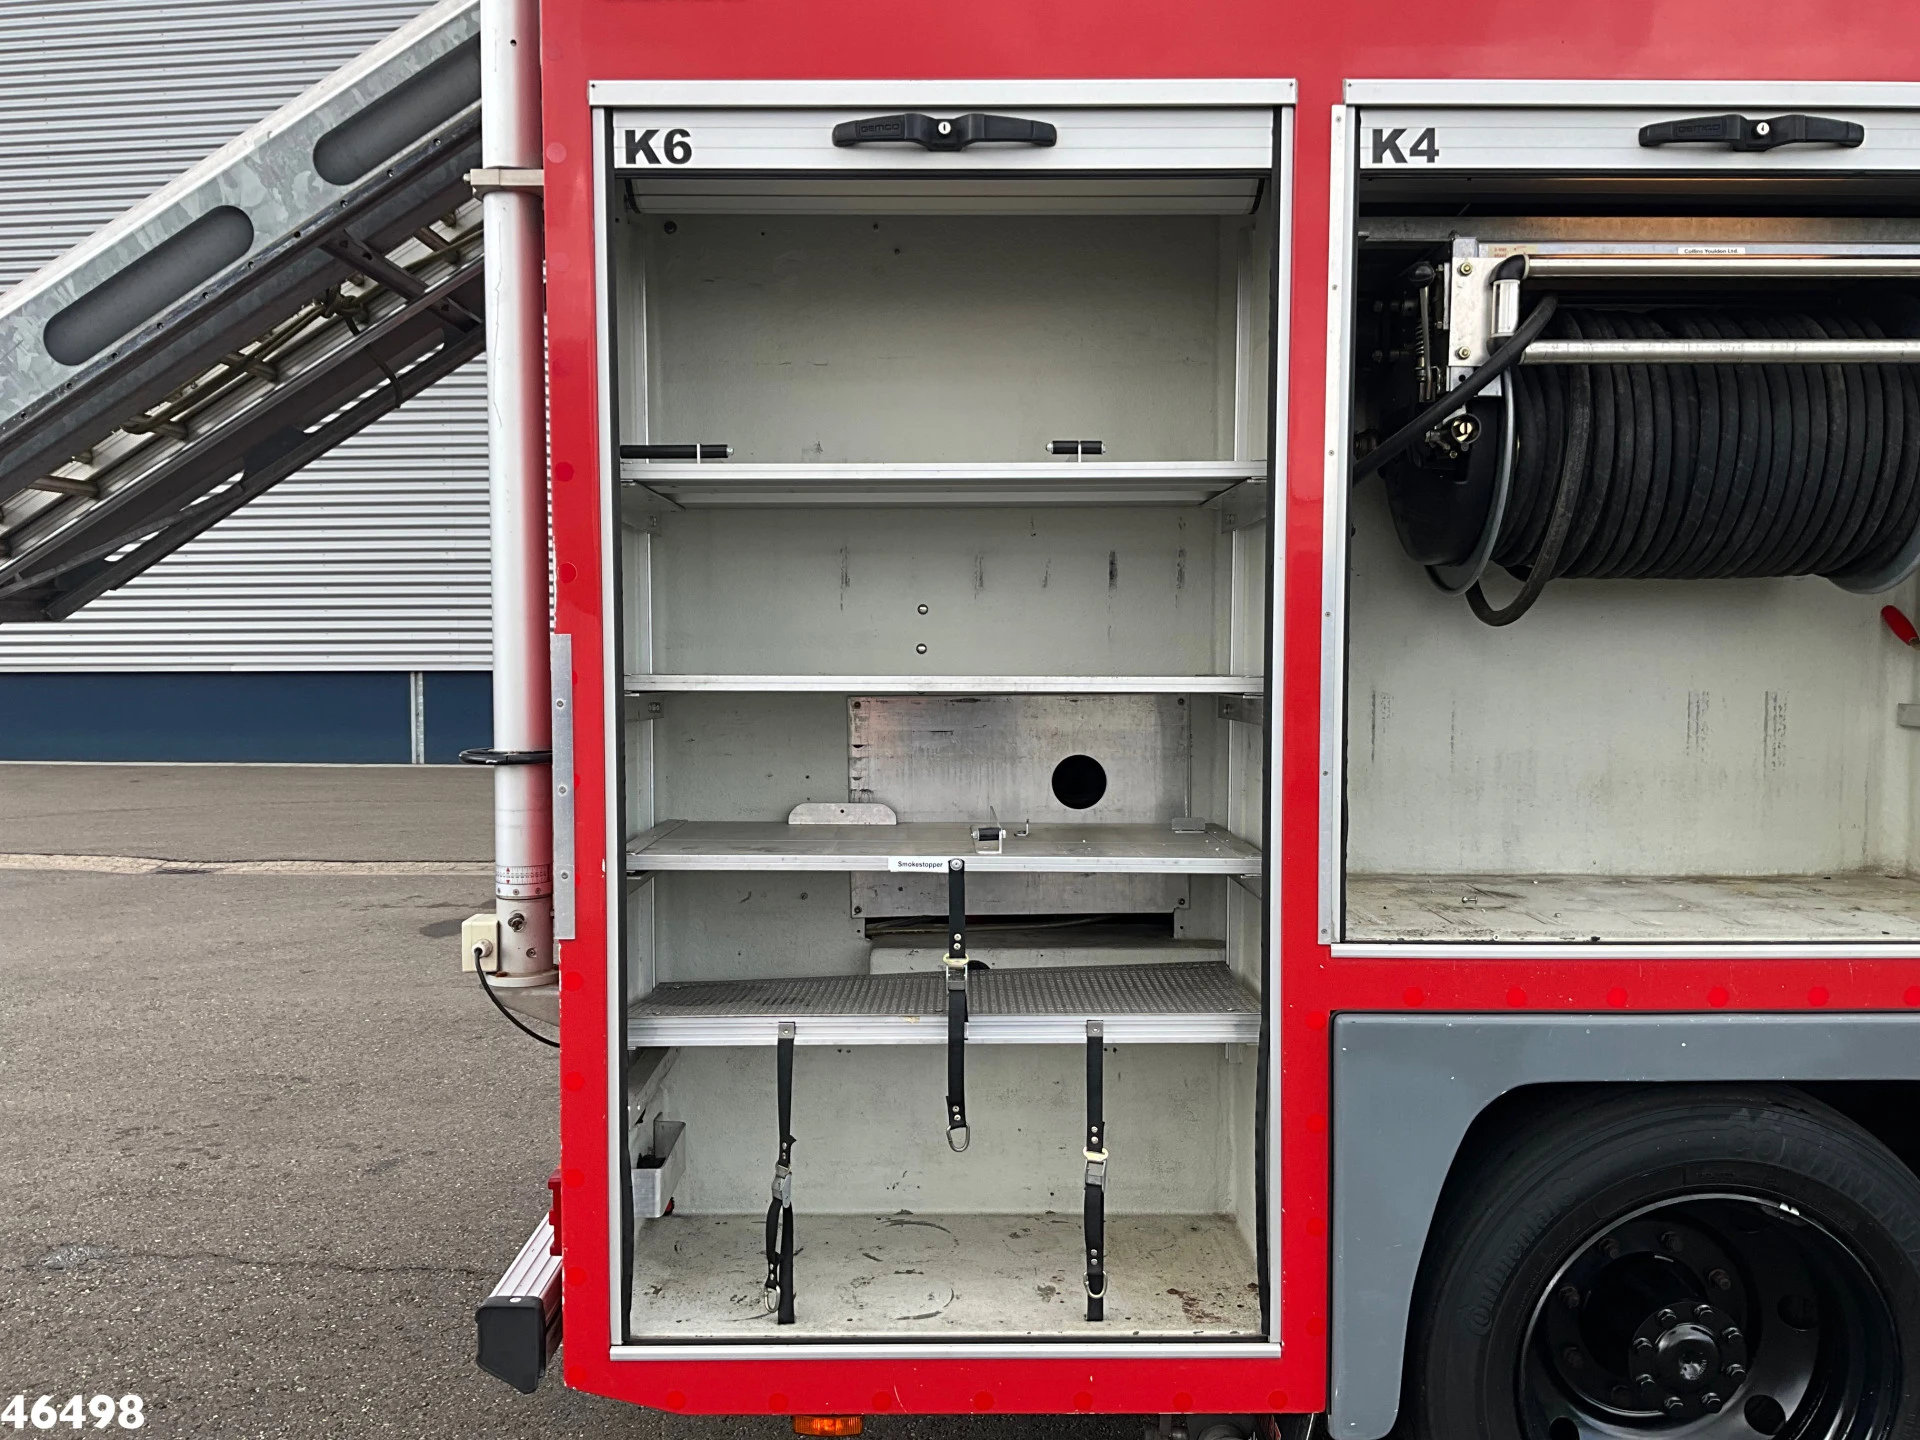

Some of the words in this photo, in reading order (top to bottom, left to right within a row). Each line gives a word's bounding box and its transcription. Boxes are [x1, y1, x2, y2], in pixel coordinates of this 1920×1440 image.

[860, 122, 900, 133] GEMCO
[625, 128, 693, 165] K6
[1373, 128, 1439, 163] K4
[897, 860, 944, 869] Smokestopper
